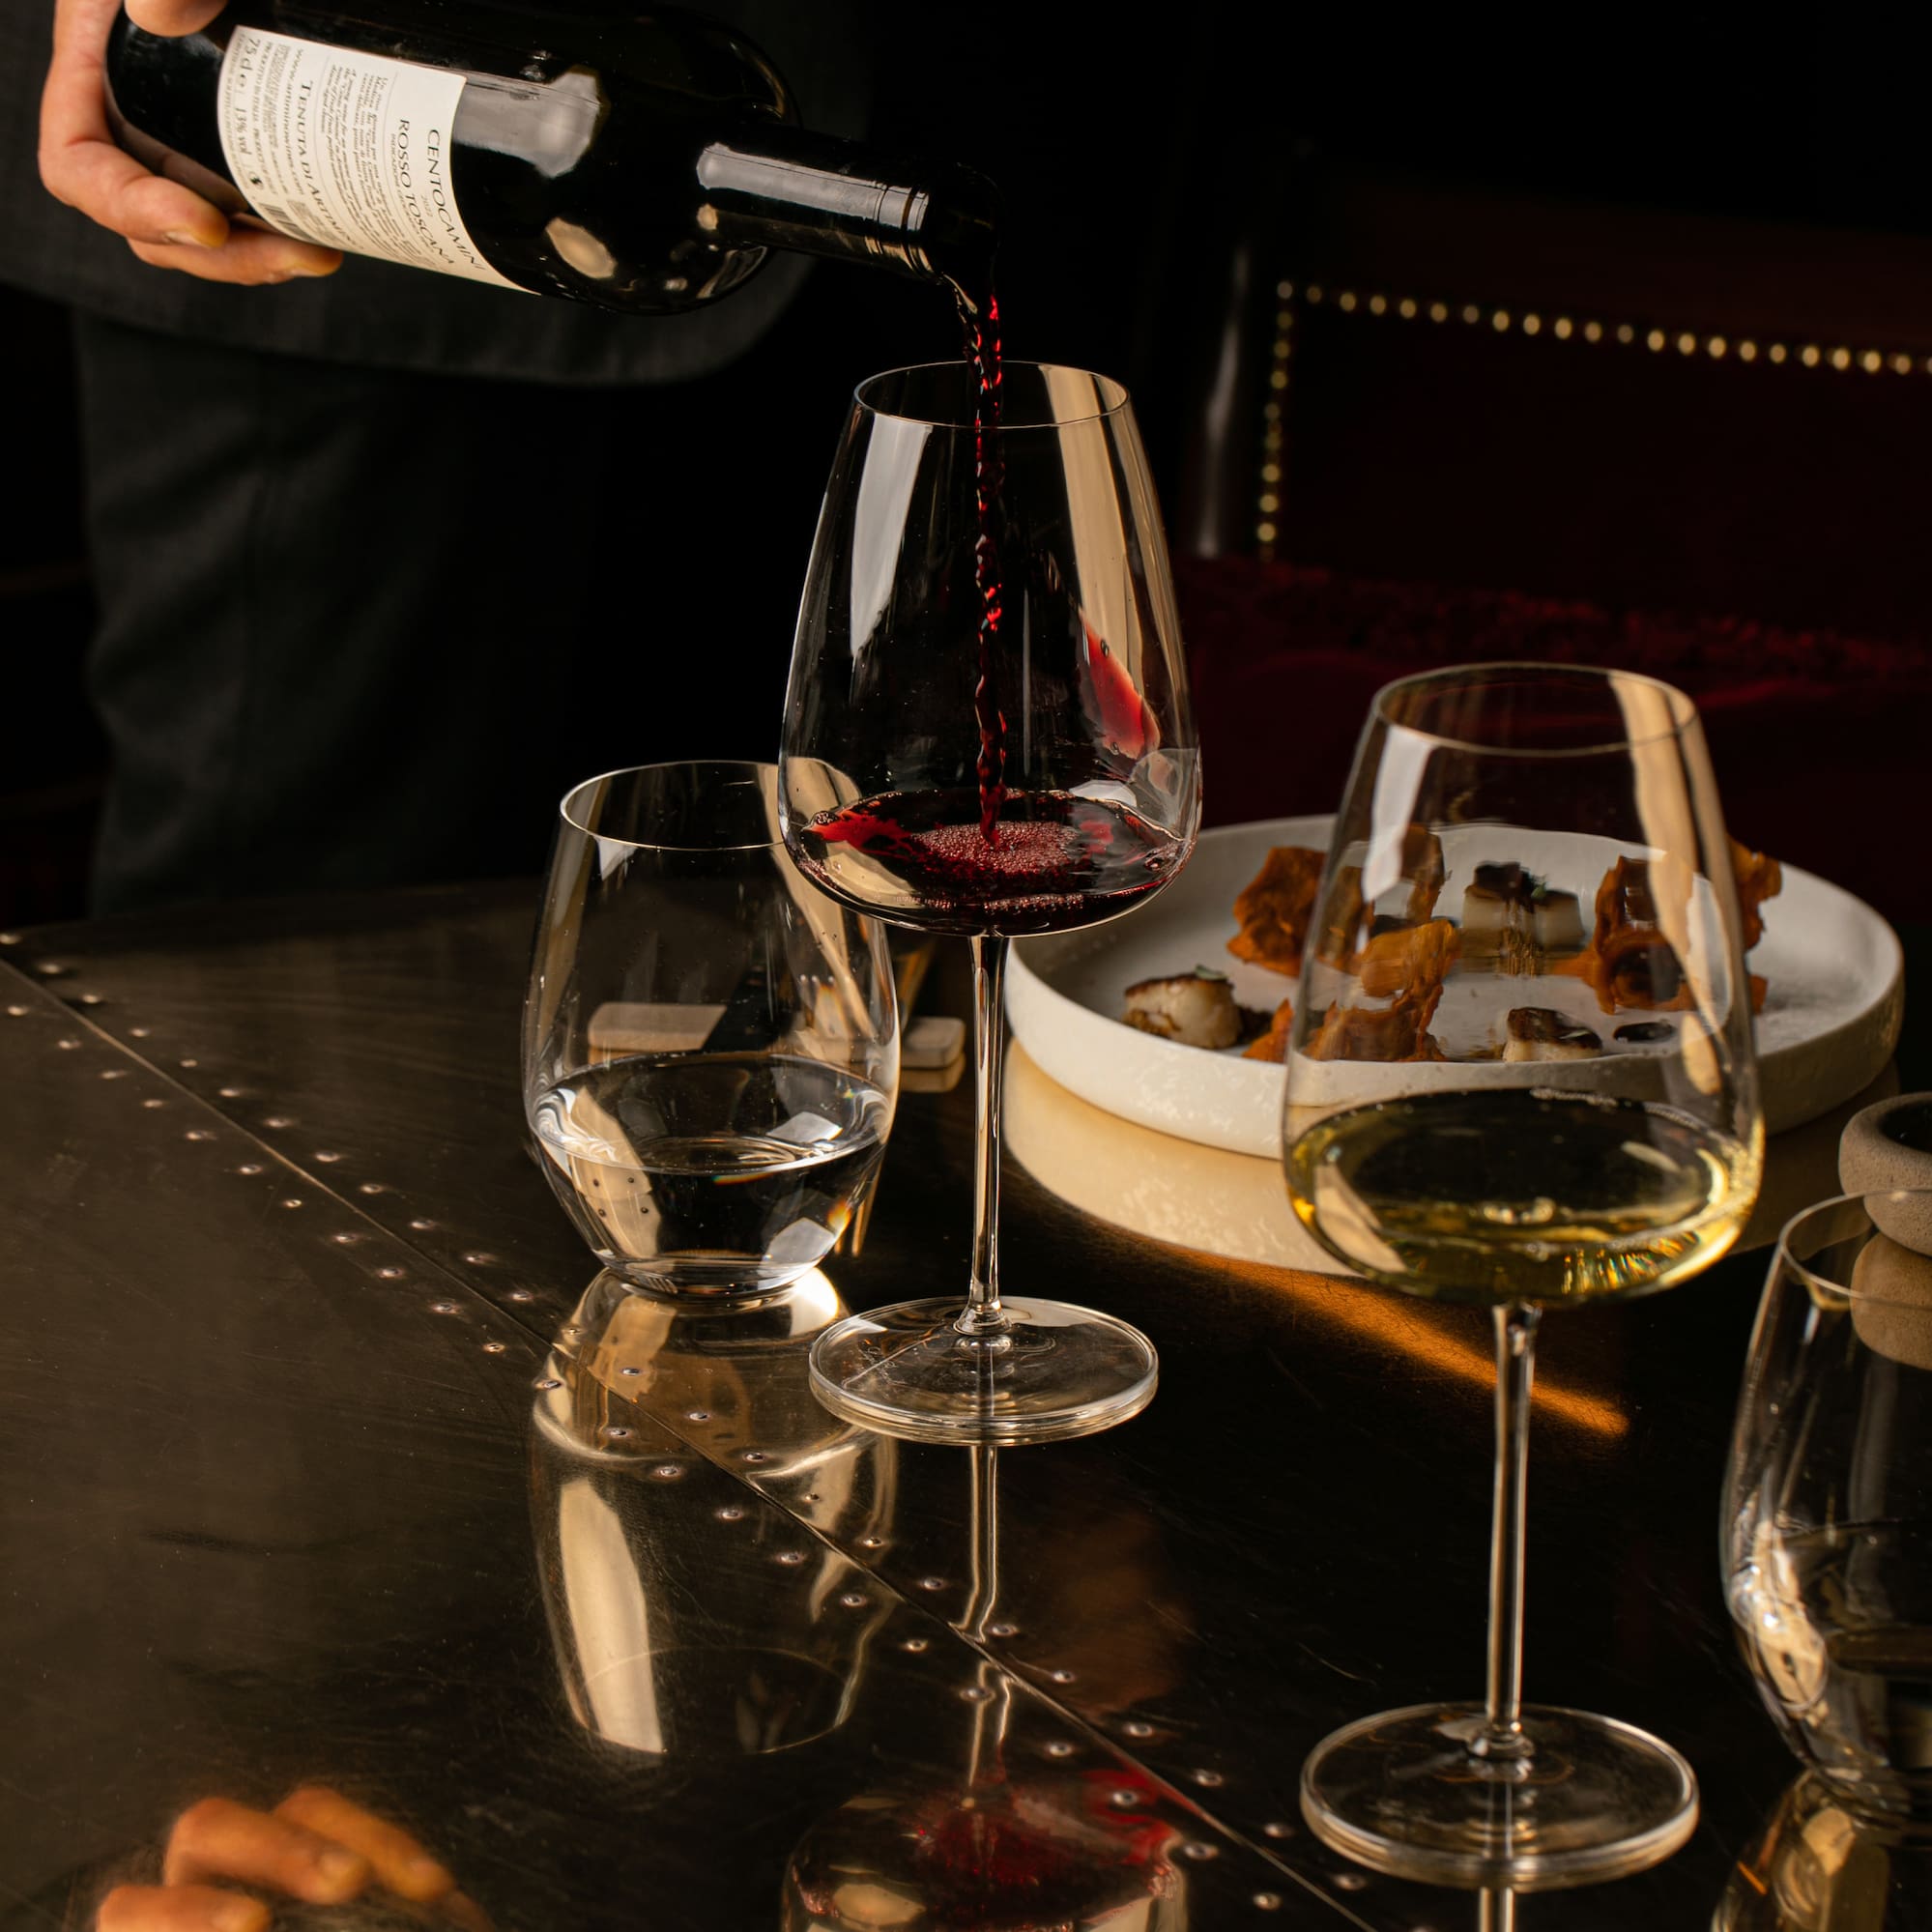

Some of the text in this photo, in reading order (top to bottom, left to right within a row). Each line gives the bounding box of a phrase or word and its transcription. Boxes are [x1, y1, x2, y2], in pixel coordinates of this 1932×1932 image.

[244, 38, 261, 55] 75
[297, 80, 314, 157] TENUTA
[397, 119, 412, 187] ROSSO
[301, 161, 313, 179] DI
[426, 129, 486, 270] CENTOCAMINI
[404, 193, 454, 264] TOSCANA
